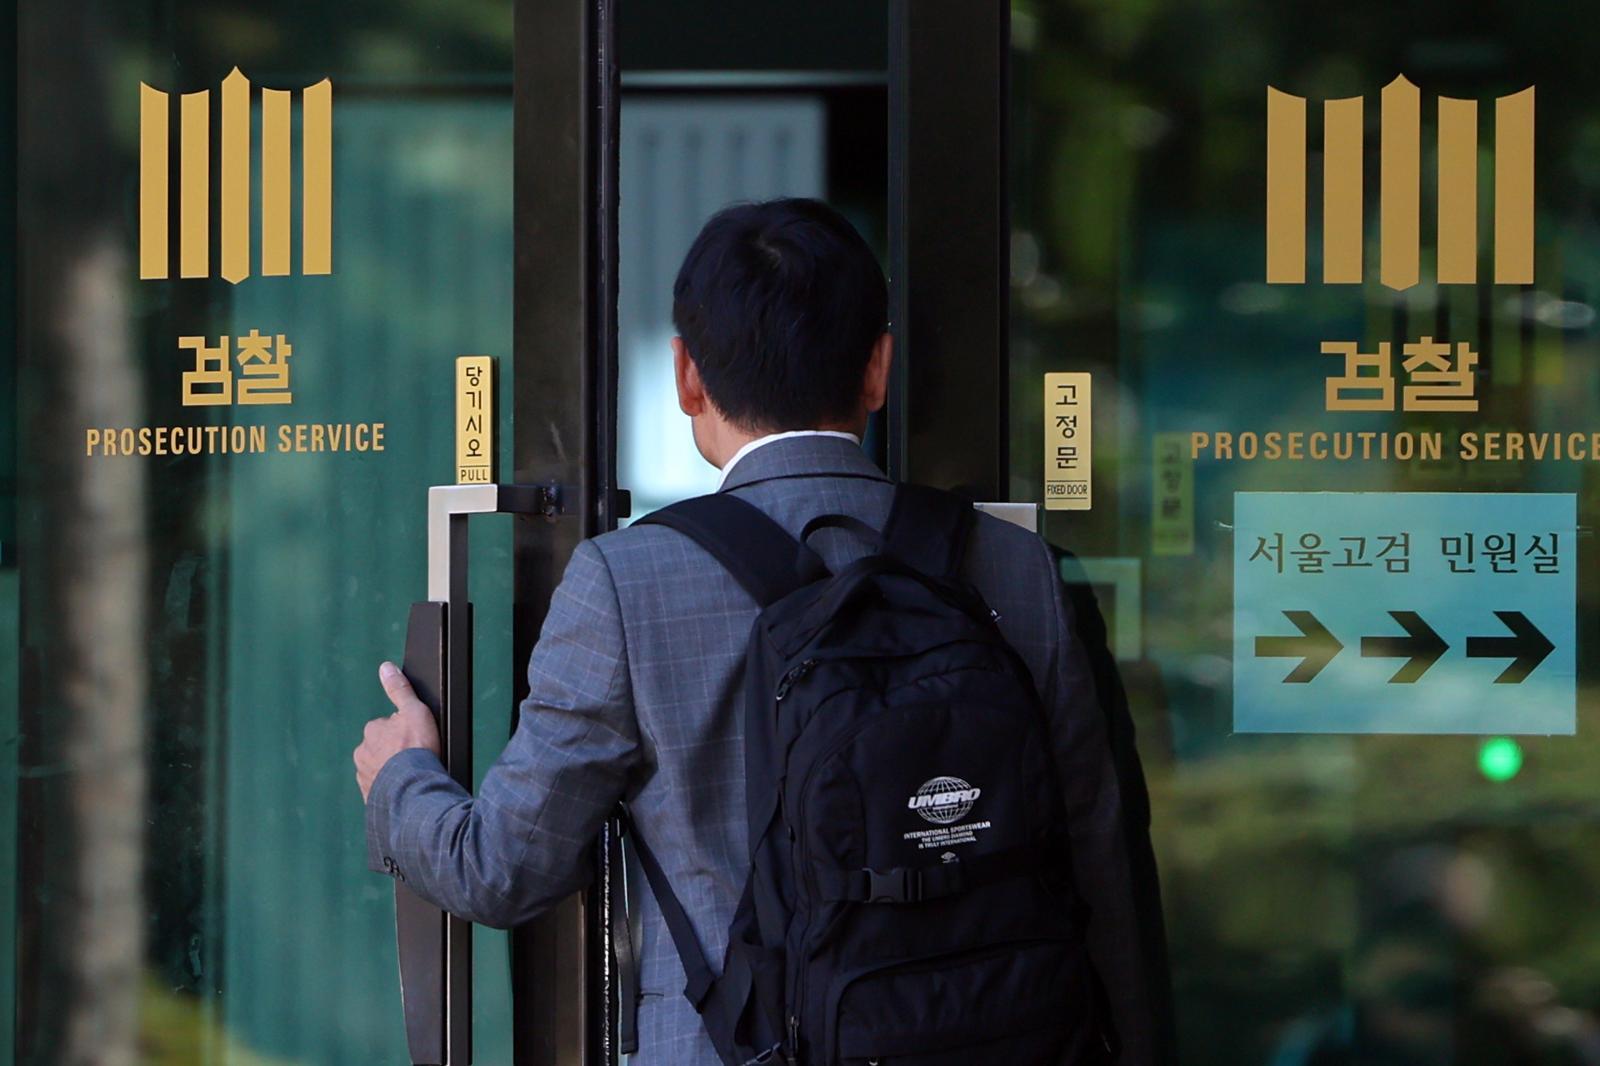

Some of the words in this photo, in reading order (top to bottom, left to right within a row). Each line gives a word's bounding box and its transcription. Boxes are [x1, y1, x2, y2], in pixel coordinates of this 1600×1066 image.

[178, 329, 293, 406] 검찰
[1321, 336, 1479, 412] 검찰
[465, 366, 483, 457] 당기시오
[1056, 385, 1078, 469] 고정문
[86, 426, 266, 457] PROSECUTION
[278, 423, 386, 453] SERVICE
[1190, 432, 1442, 461] PROSECUTION
[461, 469, 488, 481] PULL
[1047, 484, 1066, 495] FIXED
[1067, 484, 1088, 495] DOOR
[1249, 532, 1410, 574] 서울고검
[1440, 532, 1560, 574] 민원실
[908, 788, 981, 809] UMBRO
[903, 828, 949, 839] INTERNATIONAL
[950, 821, 991, 833] SPORTSWEAR
